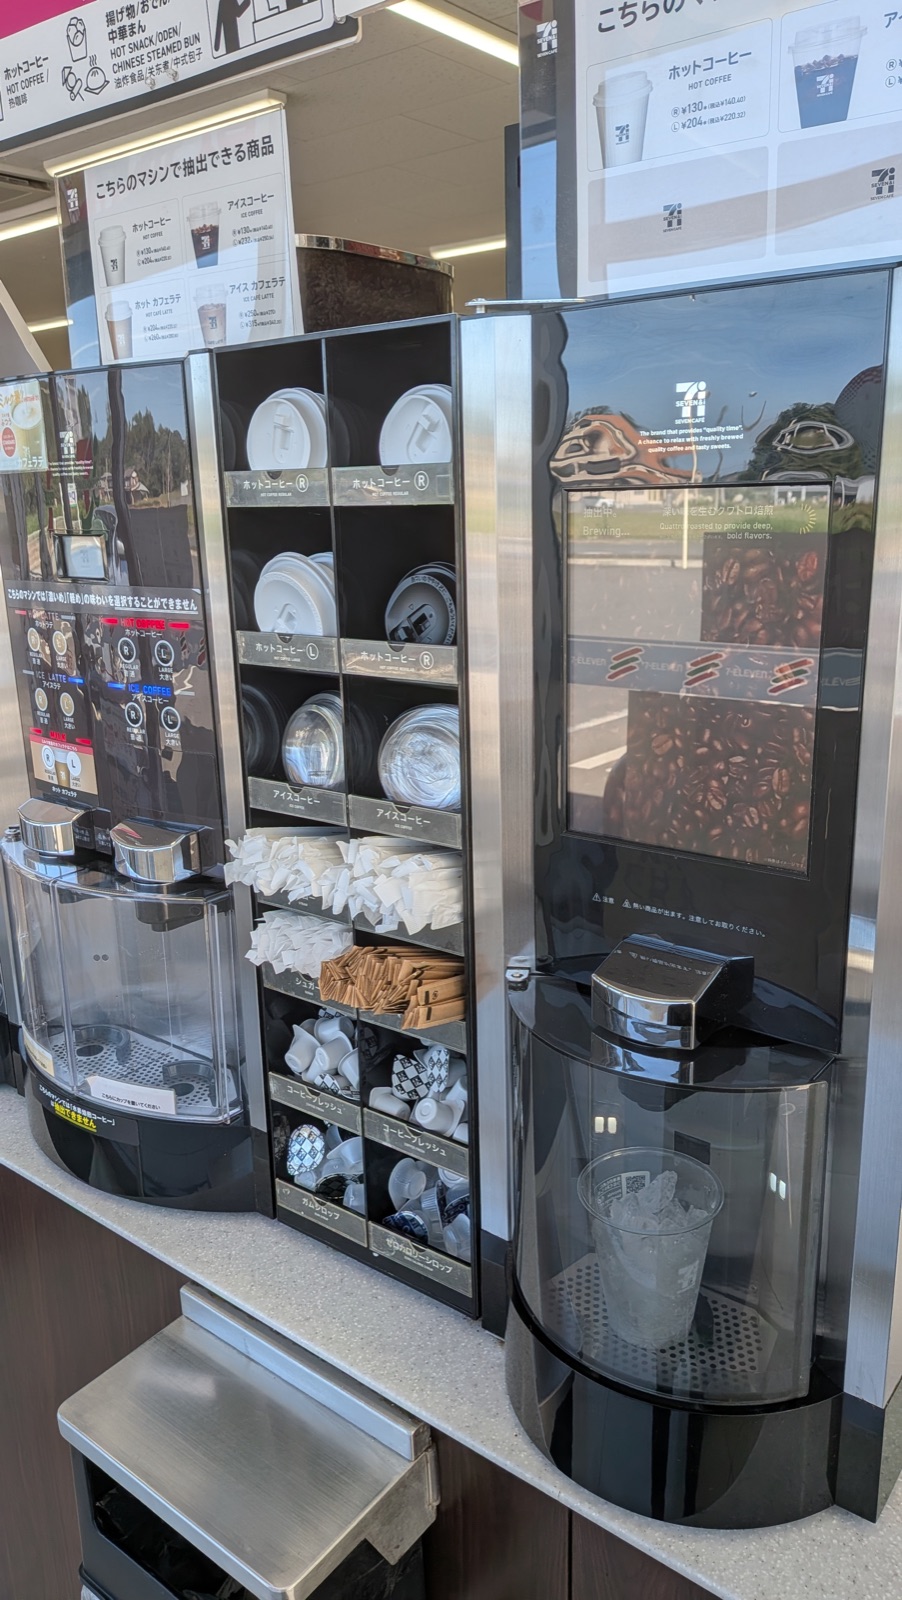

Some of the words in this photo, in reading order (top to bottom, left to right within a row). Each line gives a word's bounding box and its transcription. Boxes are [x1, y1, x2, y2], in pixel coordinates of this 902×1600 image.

[884, 11, 902, 28] ア
[108, 20, 146, 44] 中華まん
[110, 45, 126, 59] HOT
[128, 21, 181, 53] SNACK/ODEN/
[112, 54, 145, 74] CHINESE
[146, 40, 182, 62] STEAMED
[183, 32, 201, 49] BUN
[4, 56, 49, 80] ホットコーヒー
[668, 51, 752, 80] ホットコーヒー
[6, 82, 19, 95] HOT
[20, 72, 45, 90] COFFEE
[688, 80, 703, 90] HOT
[704, 74, 732, 87] COFFEE
[96, 135, 275, 199] こちらのマシンで抽出できる商品
[227, 193, 274, 211] アイスコーヒー
[248, 208, 263, 217] COFFEE
[132, 217, 172, 233] ホットコーヒー
[150, 231, 163, 239] COFFEE
[229, 282, 250, 294] アイス
[251, 276, 286, 291] カフェラテ
[135, 298, 151, 310] ホット
[152, 293, 182, 307] カフェラテ
[261, 292, 275, 300] LATTE
[678, 427, 702, 436] provides
[699, 434, 720, 442] freshly
[647, 446, 666, 454] quality
[243, 479, 293, 490] ホットコーヒー
[352, 477, 411, 489] ホットコーヒー
[583, 526, 630, 538] Brewing...
[714, 522, 722, 530] to
[723, 522, 751, 531] provide
[752, 522, 773, 531] deep,
[744, 532, 773, 540] flavors.
[120, 618, 135, 628] HOT
[124, 629, 163, 638] ホットコーヒー
[255, 642, 304, 654] ホットコーヒー
[360, 651, 416, 664] ホットコーヒー
[47, 672, 67, 683] LATTE
[42, 680, 61, 691] アイスラテ
[128, 683, 140, 693] ICE
[143, 685, 172, 697] COFFEE
[131, 693, 170, 705] アイスコーヒー
[49, 730, 66, 742] MILK
[273, 789, 321, 805] アイスコーヒー
[376, 808, 431, 825] アイスコーヒー
[602, 896, 615, 904] 注意
[101, 1092, 161, 1110] こちらにカップを置いてください
[287, 1085, 343, 1115] コーヒーフレッシュ
[382, 1123, 447, 1157] コーヒーフレッシュ
[302, 1197, 340, 1220] ガムシロップ
[385, 1237, 454, 1274] ゼロカロリーシロップ
